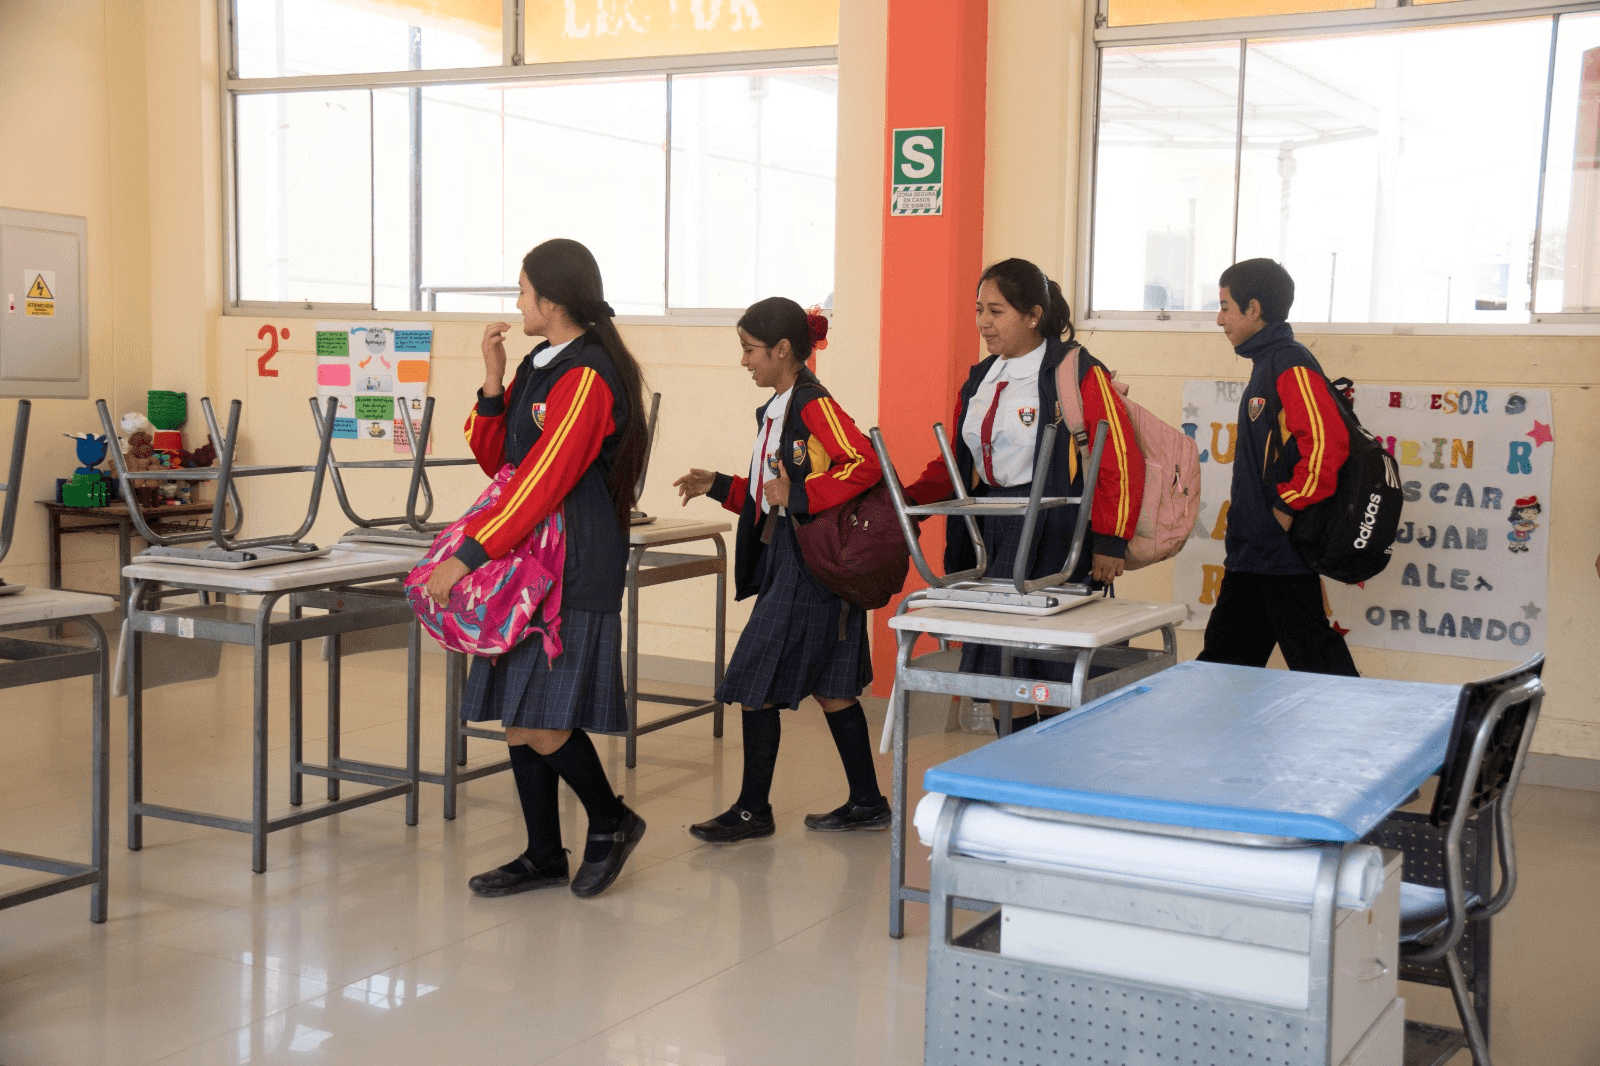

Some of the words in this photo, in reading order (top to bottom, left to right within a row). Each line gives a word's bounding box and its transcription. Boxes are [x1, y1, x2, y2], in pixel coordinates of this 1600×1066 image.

[901, 135, 935, 179] S
[1506, 441, 1532, 474] R
[1353, 493, 1382, 549] adidas
[1365, 605, 1532, 647] ORLANDO
